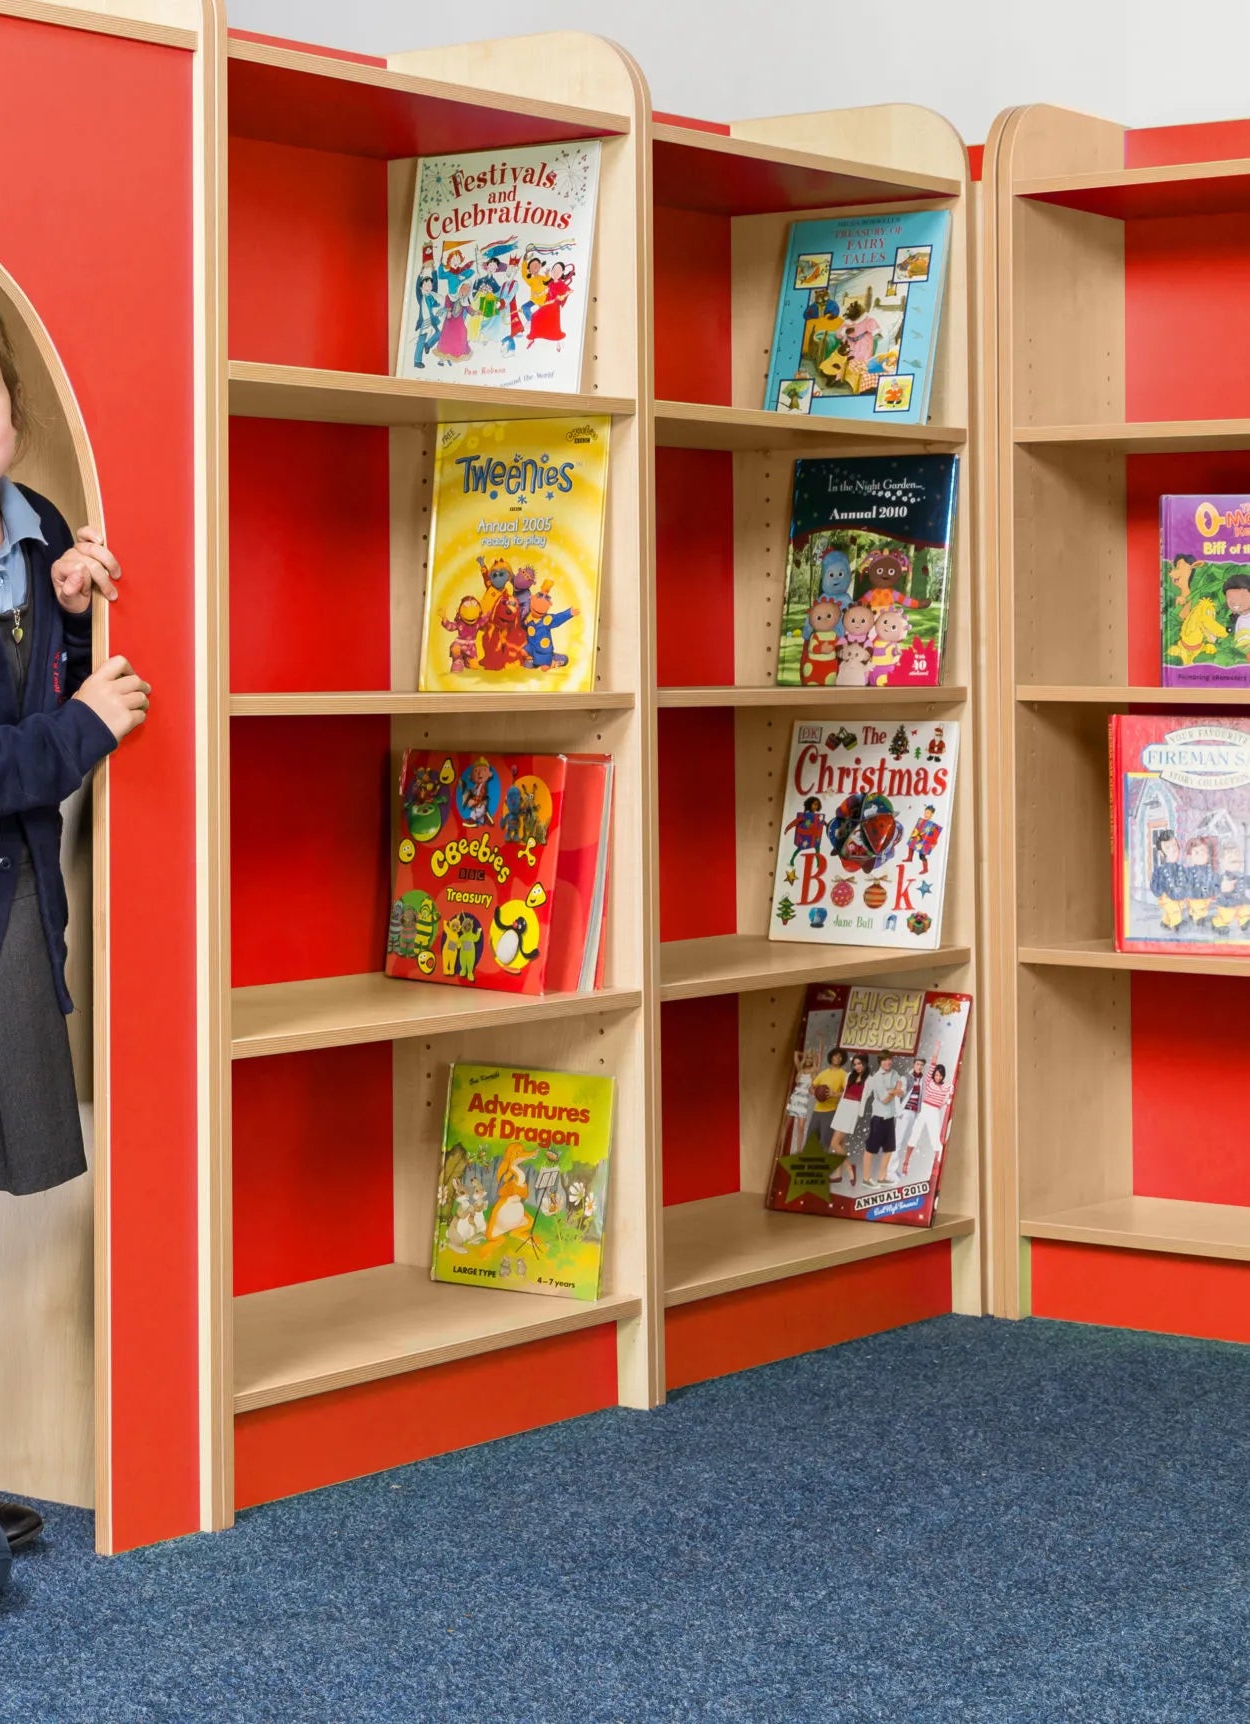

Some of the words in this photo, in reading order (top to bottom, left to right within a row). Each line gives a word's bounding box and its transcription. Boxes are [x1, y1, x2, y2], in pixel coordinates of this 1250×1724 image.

[450, 161, 558, 199] Festivals
[487, 184, 517, 204] and
[425, 201, 572, 240] Celebrations
[847, 238, 885, 250] FAIRY
[843, 252, 886, 264] TALES
[455, 454, 574, 495] Tweenies
[828, 474, 838, 492] In
[840, 480, 853, 492] the
[855, 479, 880, 493] Night
[830, 505, 877, 520] Annual
[879, 506, 908, 518] 2010
[477, 518, 519, 533] Annual
[522, 516, 552, 532] 2005
[481, 535, 510, 549] ready
[513, 535, 524, 545] to
[525, 534, 547, 549] play
[1203, 541, 1227, 555] Biff
[1229, 543, 1241, 554] of
[862, 726, 887, 745] The
[1147, 751, 1229, 765] FIREMAN
[1235, 751, 1250, 766] S
[794, 744, 948, 797] Christmas
[459, 868, 485, 881] BBC
[446, 887, 493, 908] Treasury
[850, 991, 923, 1016] HIGH
[846, 1012, 916, 1033] SCHOOL
[842, 1029, 914, 1050] MUSICAL
[511, 1072, 550, 1096] The
[468, 1093, 591, 1123] Adventures
[474, 1120, 497, 1138] of
[500, 1121, 580, 1149] Dragon
[856, 1190, 901, 1209] ANNUAL
[903, 1183, 928, 1197] 2010
[453, 1265, 478, 1276] LARGE
[478, 1269, 497, 1278] TYPE
[554, 1279, 576, 1288] years
